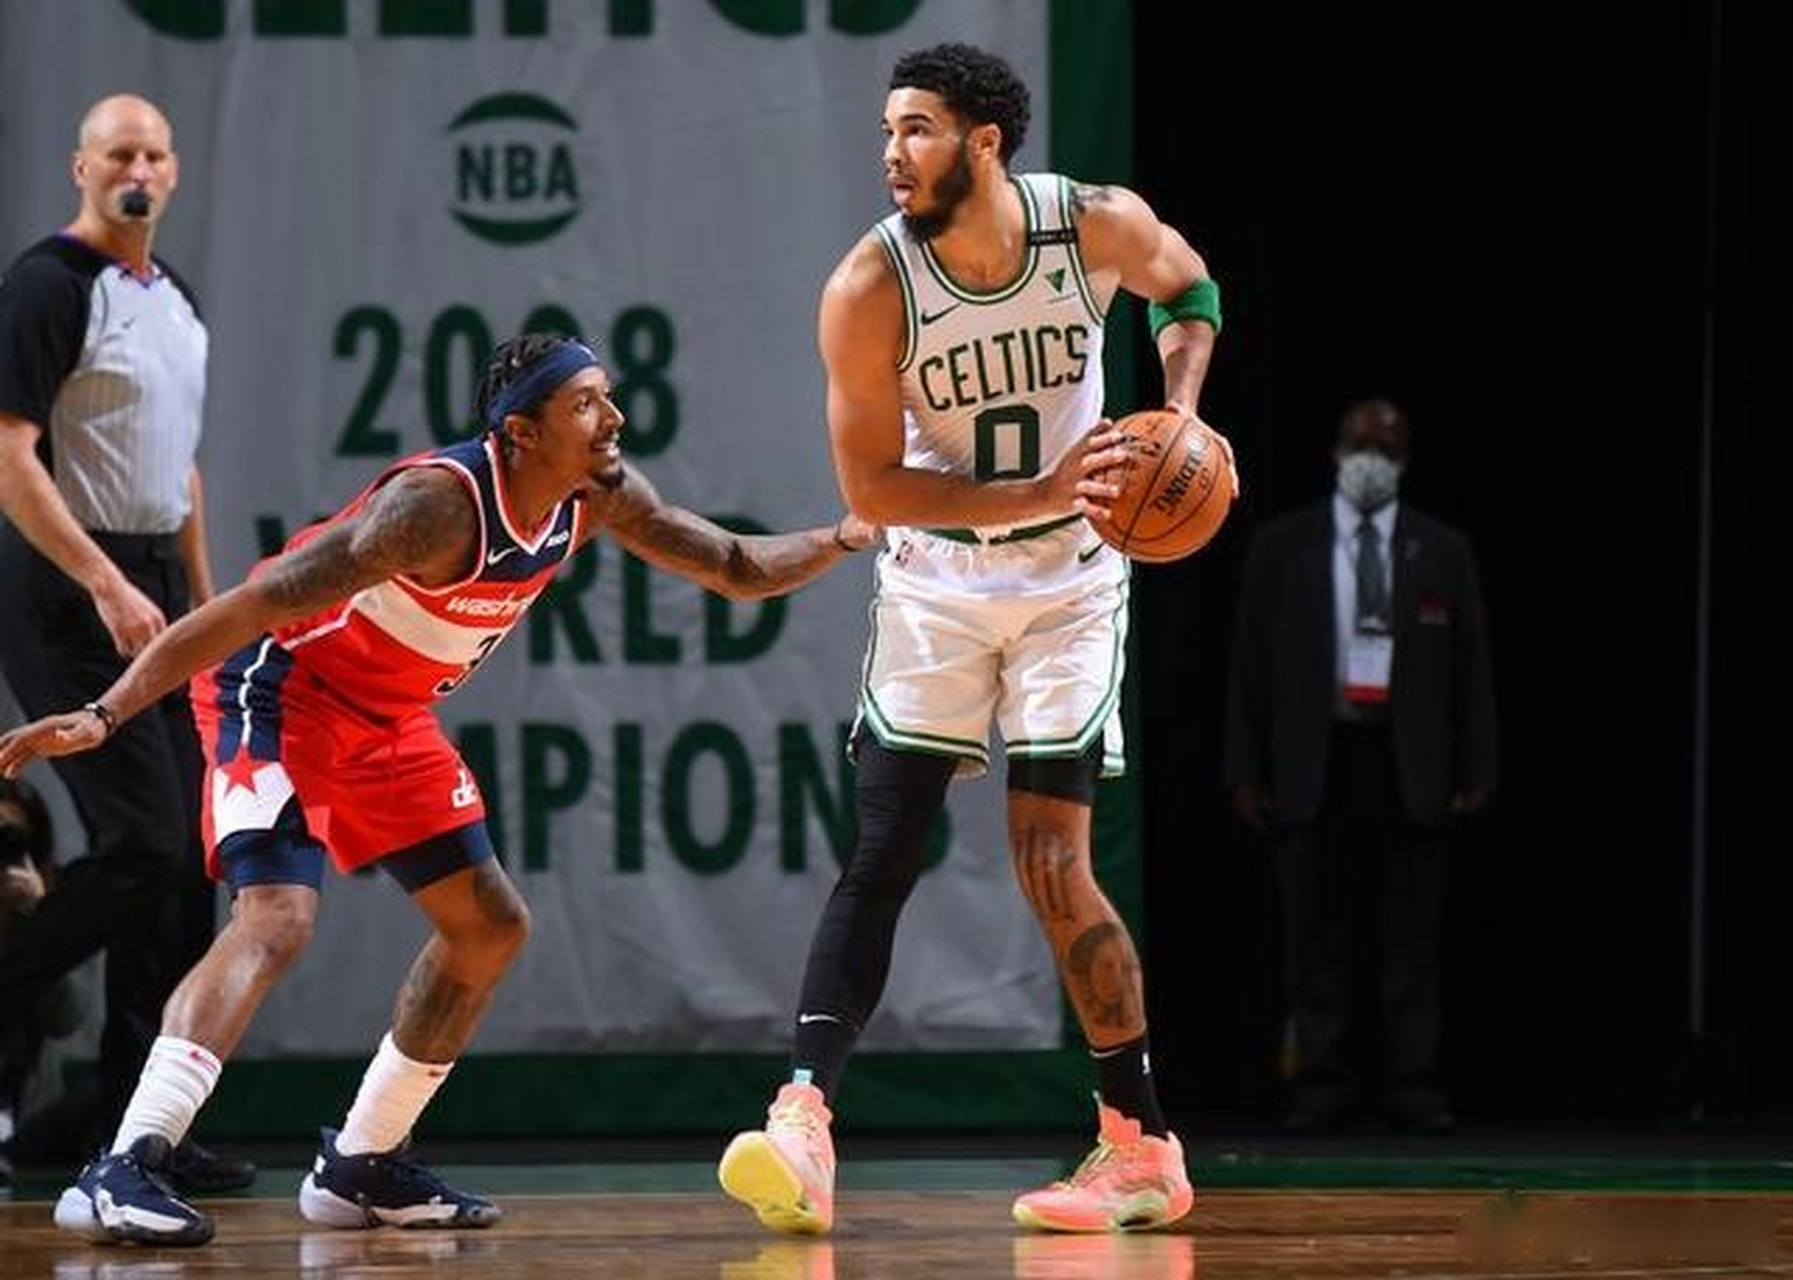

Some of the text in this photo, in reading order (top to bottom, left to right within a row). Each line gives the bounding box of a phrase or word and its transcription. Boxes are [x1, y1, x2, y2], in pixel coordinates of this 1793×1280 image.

[457, 144, 579, 201] NBA
[919, 325, 1088, 412] CELTICS
[974, 404, 1040, 482] 0
